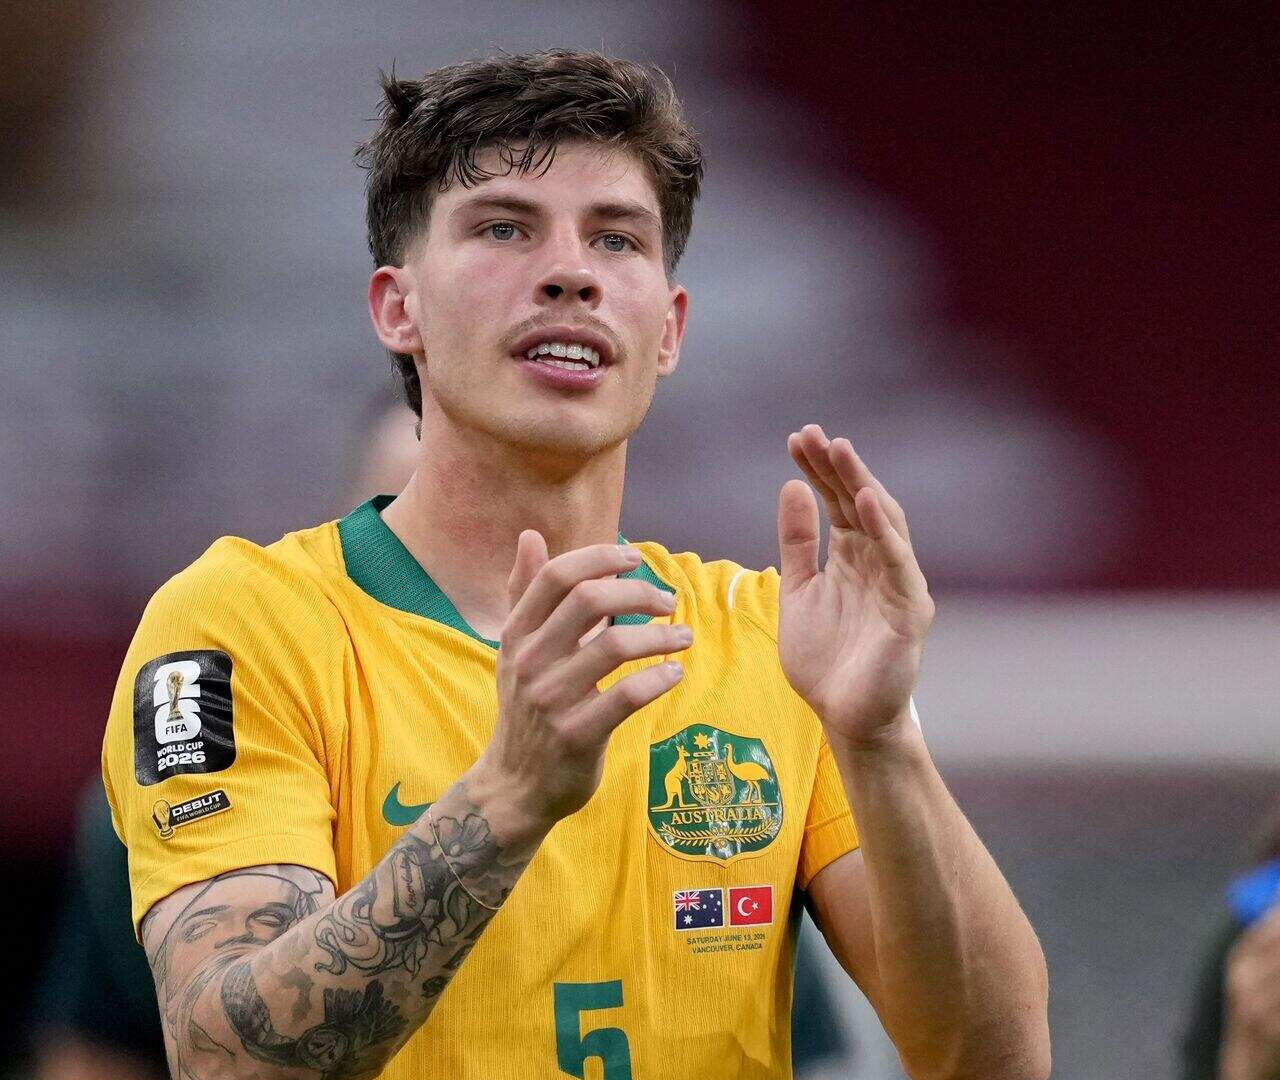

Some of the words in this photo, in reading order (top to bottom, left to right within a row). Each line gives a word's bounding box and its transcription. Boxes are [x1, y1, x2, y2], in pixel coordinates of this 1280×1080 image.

[165, 723, 188, 735] FIFA
[156, 744, 185, 758] WORLD
[186, 741, 204, 751] CUP
[157, 751, 206, 771] 2026
[171, 792, 222, 817] DEBUT
[189, 806, 210, 818] WORLD
[209, 802, 222, 811] CUP
[671, 808, 762, 825] AUSTRALIA
[686, 935, 723, 945] SATURDAY
[723, 934, 742, 942] JUNE
[735, 943, 763, 951] CANADA
